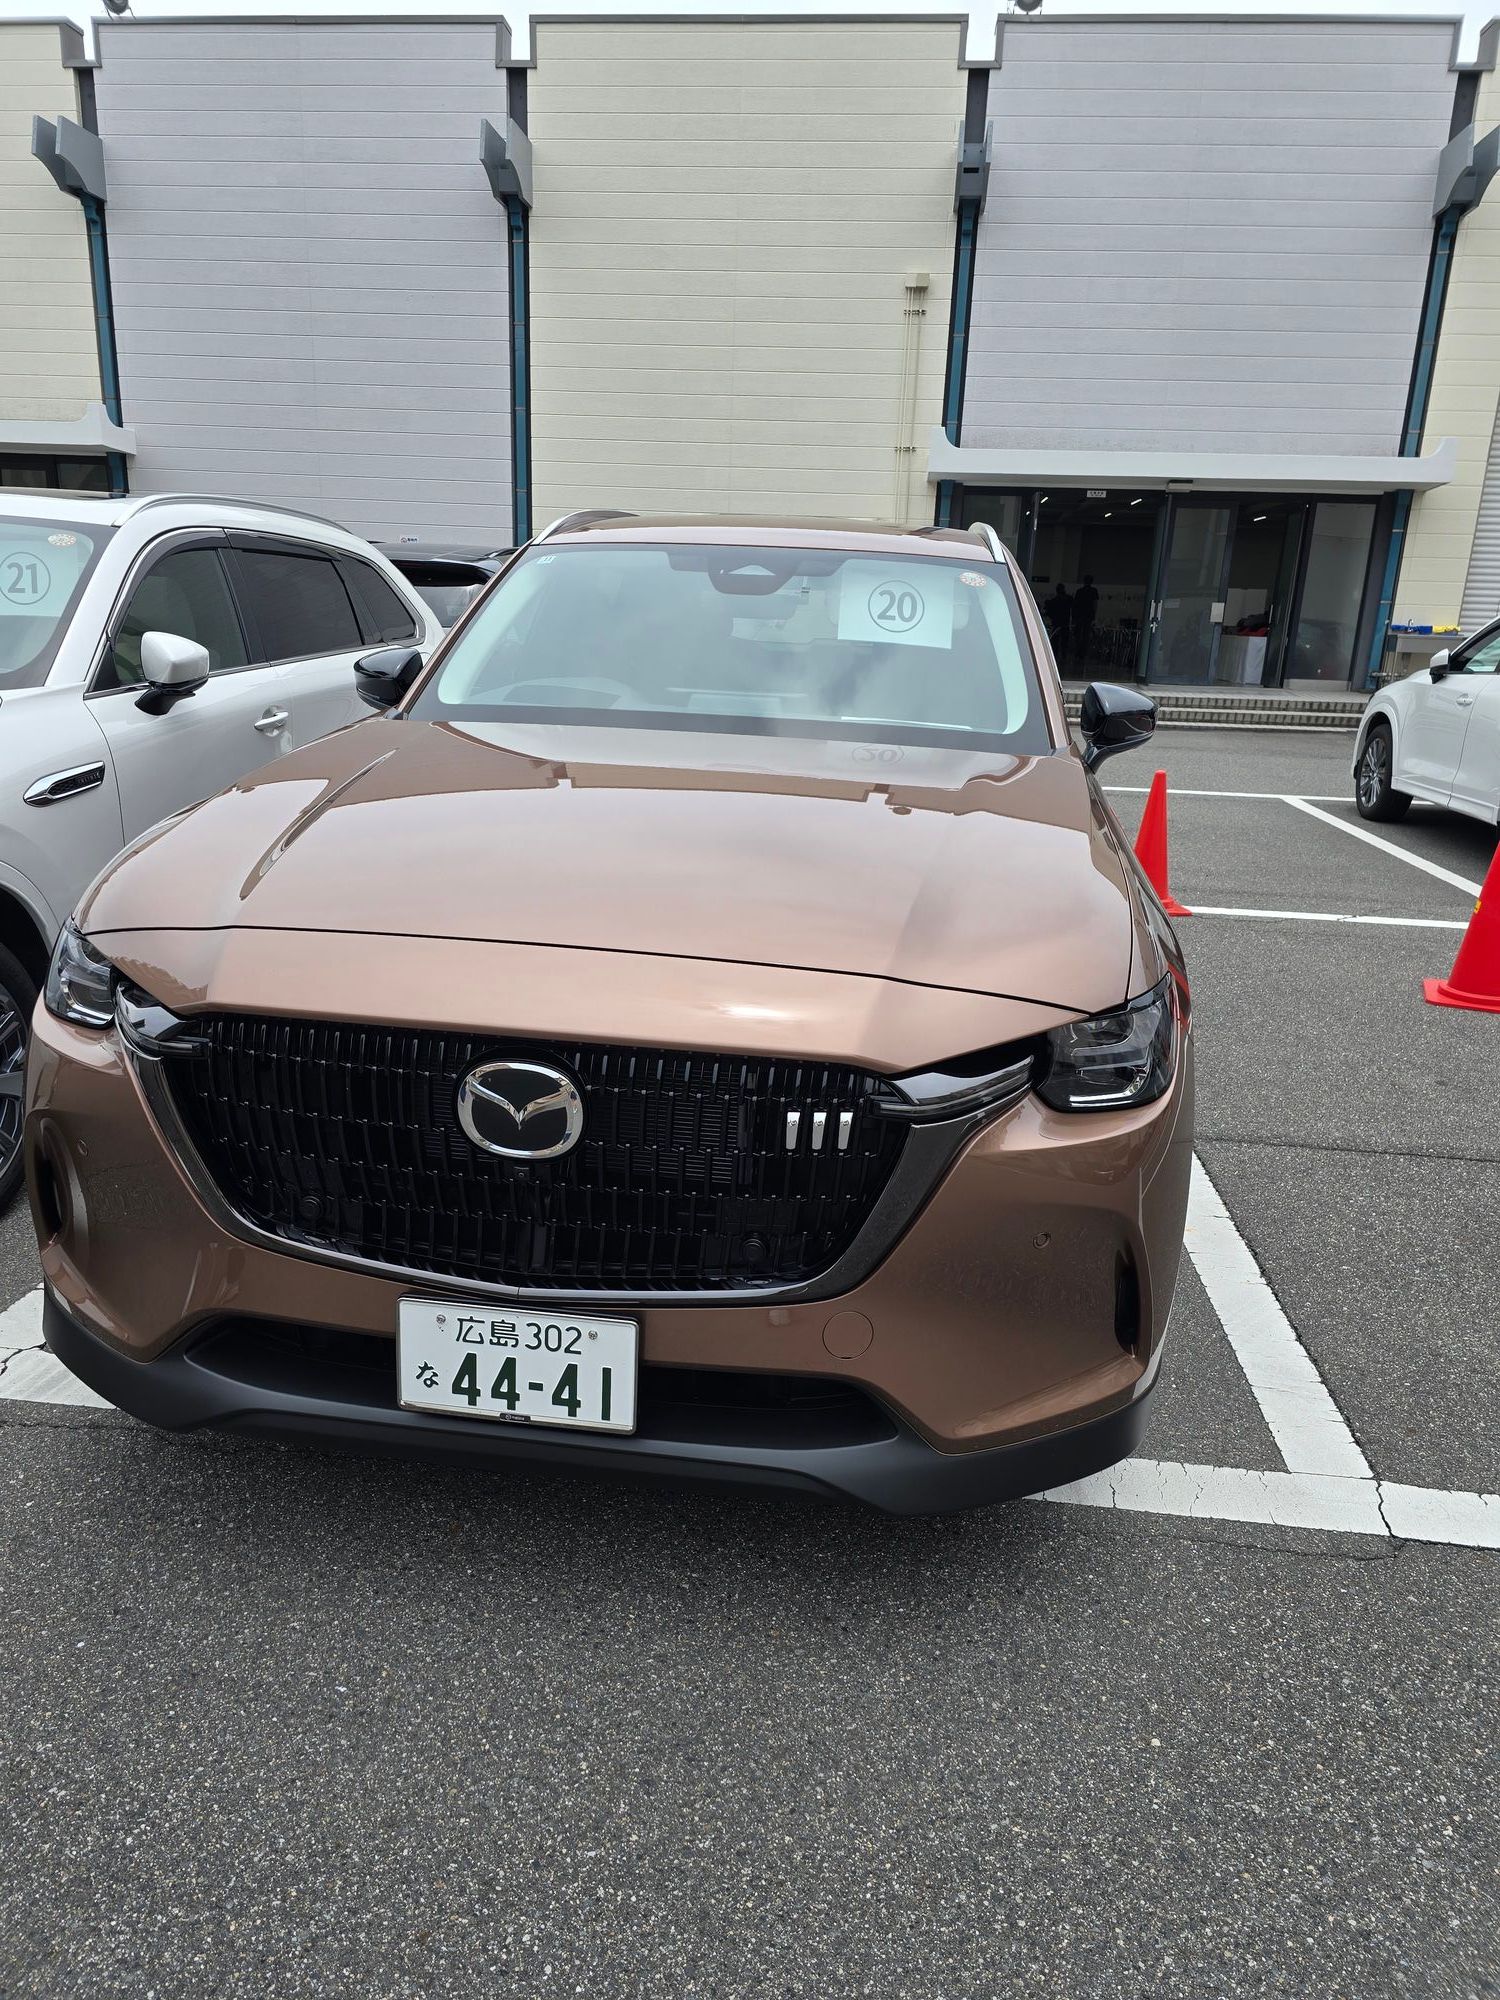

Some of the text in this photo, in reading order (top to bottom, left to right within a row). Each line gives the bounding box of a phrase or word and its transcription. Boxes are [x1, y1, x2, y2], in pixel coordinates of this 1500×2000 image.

[7, 562, 39, 594] 21
[877, 589, 918, 623] 20
[415, 1352, 612, 1421] な 44-41
